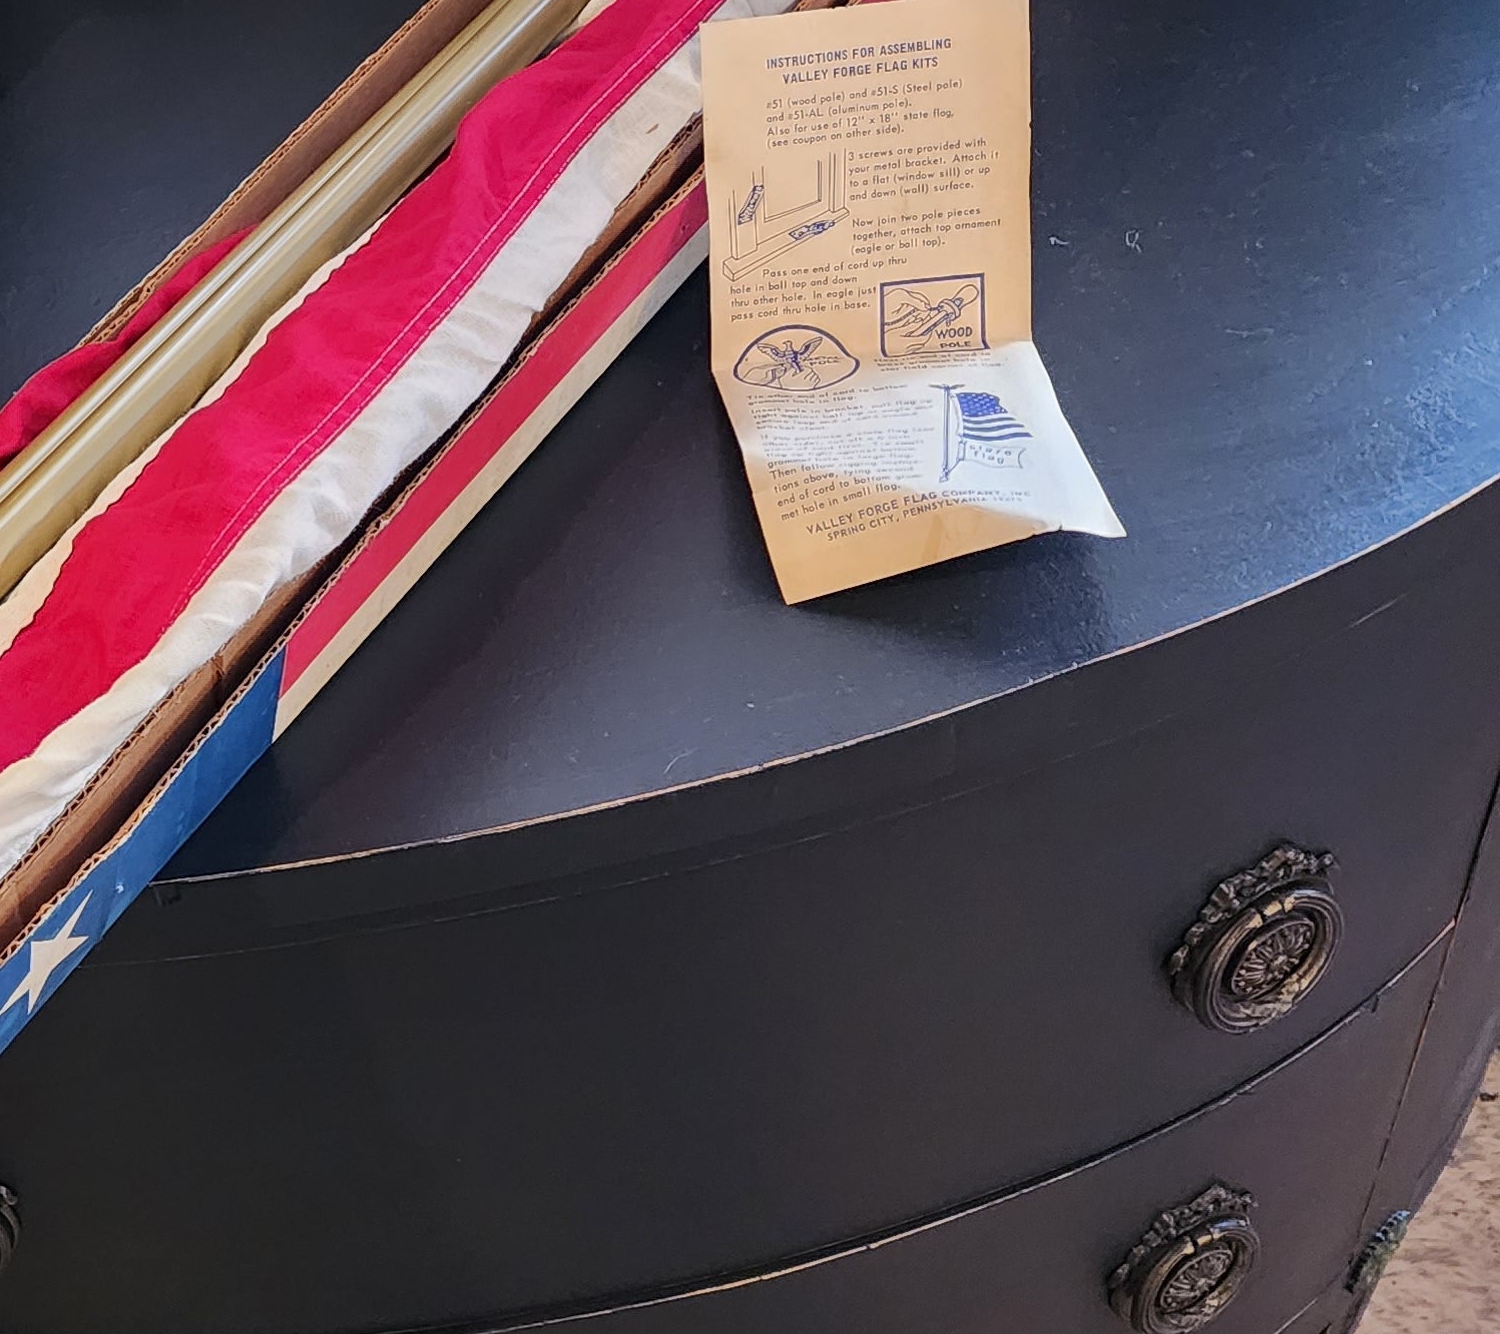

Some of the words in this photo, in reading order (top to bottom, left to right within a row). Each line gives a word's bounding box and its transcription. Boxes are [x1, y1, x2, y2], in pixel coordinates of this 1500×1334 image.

[767, 50, 848, 69] INSTRUCTIONS
[853, 47, 874, 58] FOR
[880, 39, 951, 55] ASSEMBLING
[783, 69, 828, 84] VALLEY
[834, 65, 871, 78] FORGE
[877, 61, 907, 73] FLAG
[913, 57, 938, 69] KITS
[788, 95, 816, 108] (wood
[820, 91, 845, 105] pole)
[850, 88, 867, 99] and
[903, 82, 931, 94] (Steel
[936, 79, 962, 91] pole)
[767, 114, 784, 123] and
[829, 103, 879, 116] (aluminum
[767, 127, 790, 136] Also
[795, 124, 807, 133] for
[811, 123, 829, 131] use
[833, 120, 842, 129] of
[903, 110, 928, 120] state
[767, 138, 788, 149] (see
[793, 133, 827, 146] coupon
[831, 132, 842, 140] on
[846, 128, 871, 138] other
[848, 152, 854, 161] 3
[859, 149, 893, 159] screws
[917, 140, 960, 155] provided
[965, 137, 986, 148] with
[849, 166, 869, 176] your
[874, 160, 900, 171] metal
[952, 151, 986, 163] Attach
[991, 151, 999, 159] it
[850, 179, 858, 187] to
[873, 175, 889, 185] flat
[894, 171, 935, 184] (window
[940, 167, 960, 178] sill)
[979, 167, 990, 175] up
[850, 190, 867, 201] and
[871, 186, 896, 198] down
[900, 184, 929, 195] (wall)
[852, 218, 873, 228] Now
[878, 216, 896, 227] join
[901, 213, 918, 222] two
[922, 209, 943, 222] pole
[947, 207, 980, 219] pieces
[901, 224, 931, 235] attach
[936, 224, 951, 234] top
[955, 218, 1001, 230] ornament
[852, 242, 881, 255] (eagle
[899, 238, 917, 249] ball
[763, 269, 787, 278] Pass
[791, 267, 809, 275] one
[812, 263, 830, 273] end
[834, 262, 844, 271] of
[848, 259, 868, 270] cord
[872, 259, 884, 269] up
[888, 256, 907, 265] thru
[730, 285, 751, 295] hole
[755, 284, 764, 292] in
[769, 280, 787, 290] ball
[792, 281, 807, 289] top
[811, 277, 828, 286] and
[832, 275, 858, 285] down
[731, 298, 749, 307] thru
[753, 295, 778, 305] other
[813, 291, 822, 299] In
[827, 289, 853, 300] eagle
[858, 286, 876, 297] just
[731, 312, 753, 322] pass
[758, 308, 778, 317] cord
[783, 305, 801, 315] thru
[805, 303, 826, 313] hole
[831, 301, 840, 311] in
[935, 327, 972, 339] WOOD
[940, 341, 971, 349] POLE
[770, 468, 796, 480] Then
[774, 481, 799, 494] tions
[804, 473, 838, 484] above,
[777, 494, 796, 507] end
[799, 489, 809, 500] of
[813, 483, 835, 496] cord
[840, 480, 849, 488] to
[854, 475, 890, 484] bottom
[781, 508, 799, 521] met
[802, 501, 825, 515] hole
[828, 498, 839, 507] in
[843, 487, 871, 502] small
[806, 513, 853, 535] VALLEY
[858, 499, 898, 519] FORGE
[904, 491, 937, 506] FLAG
[827, 523, 866, 541] SPRING
[869, 514, 900, 529] CITY,
[903, 497, 986, 517] PENNSYLVANIA
